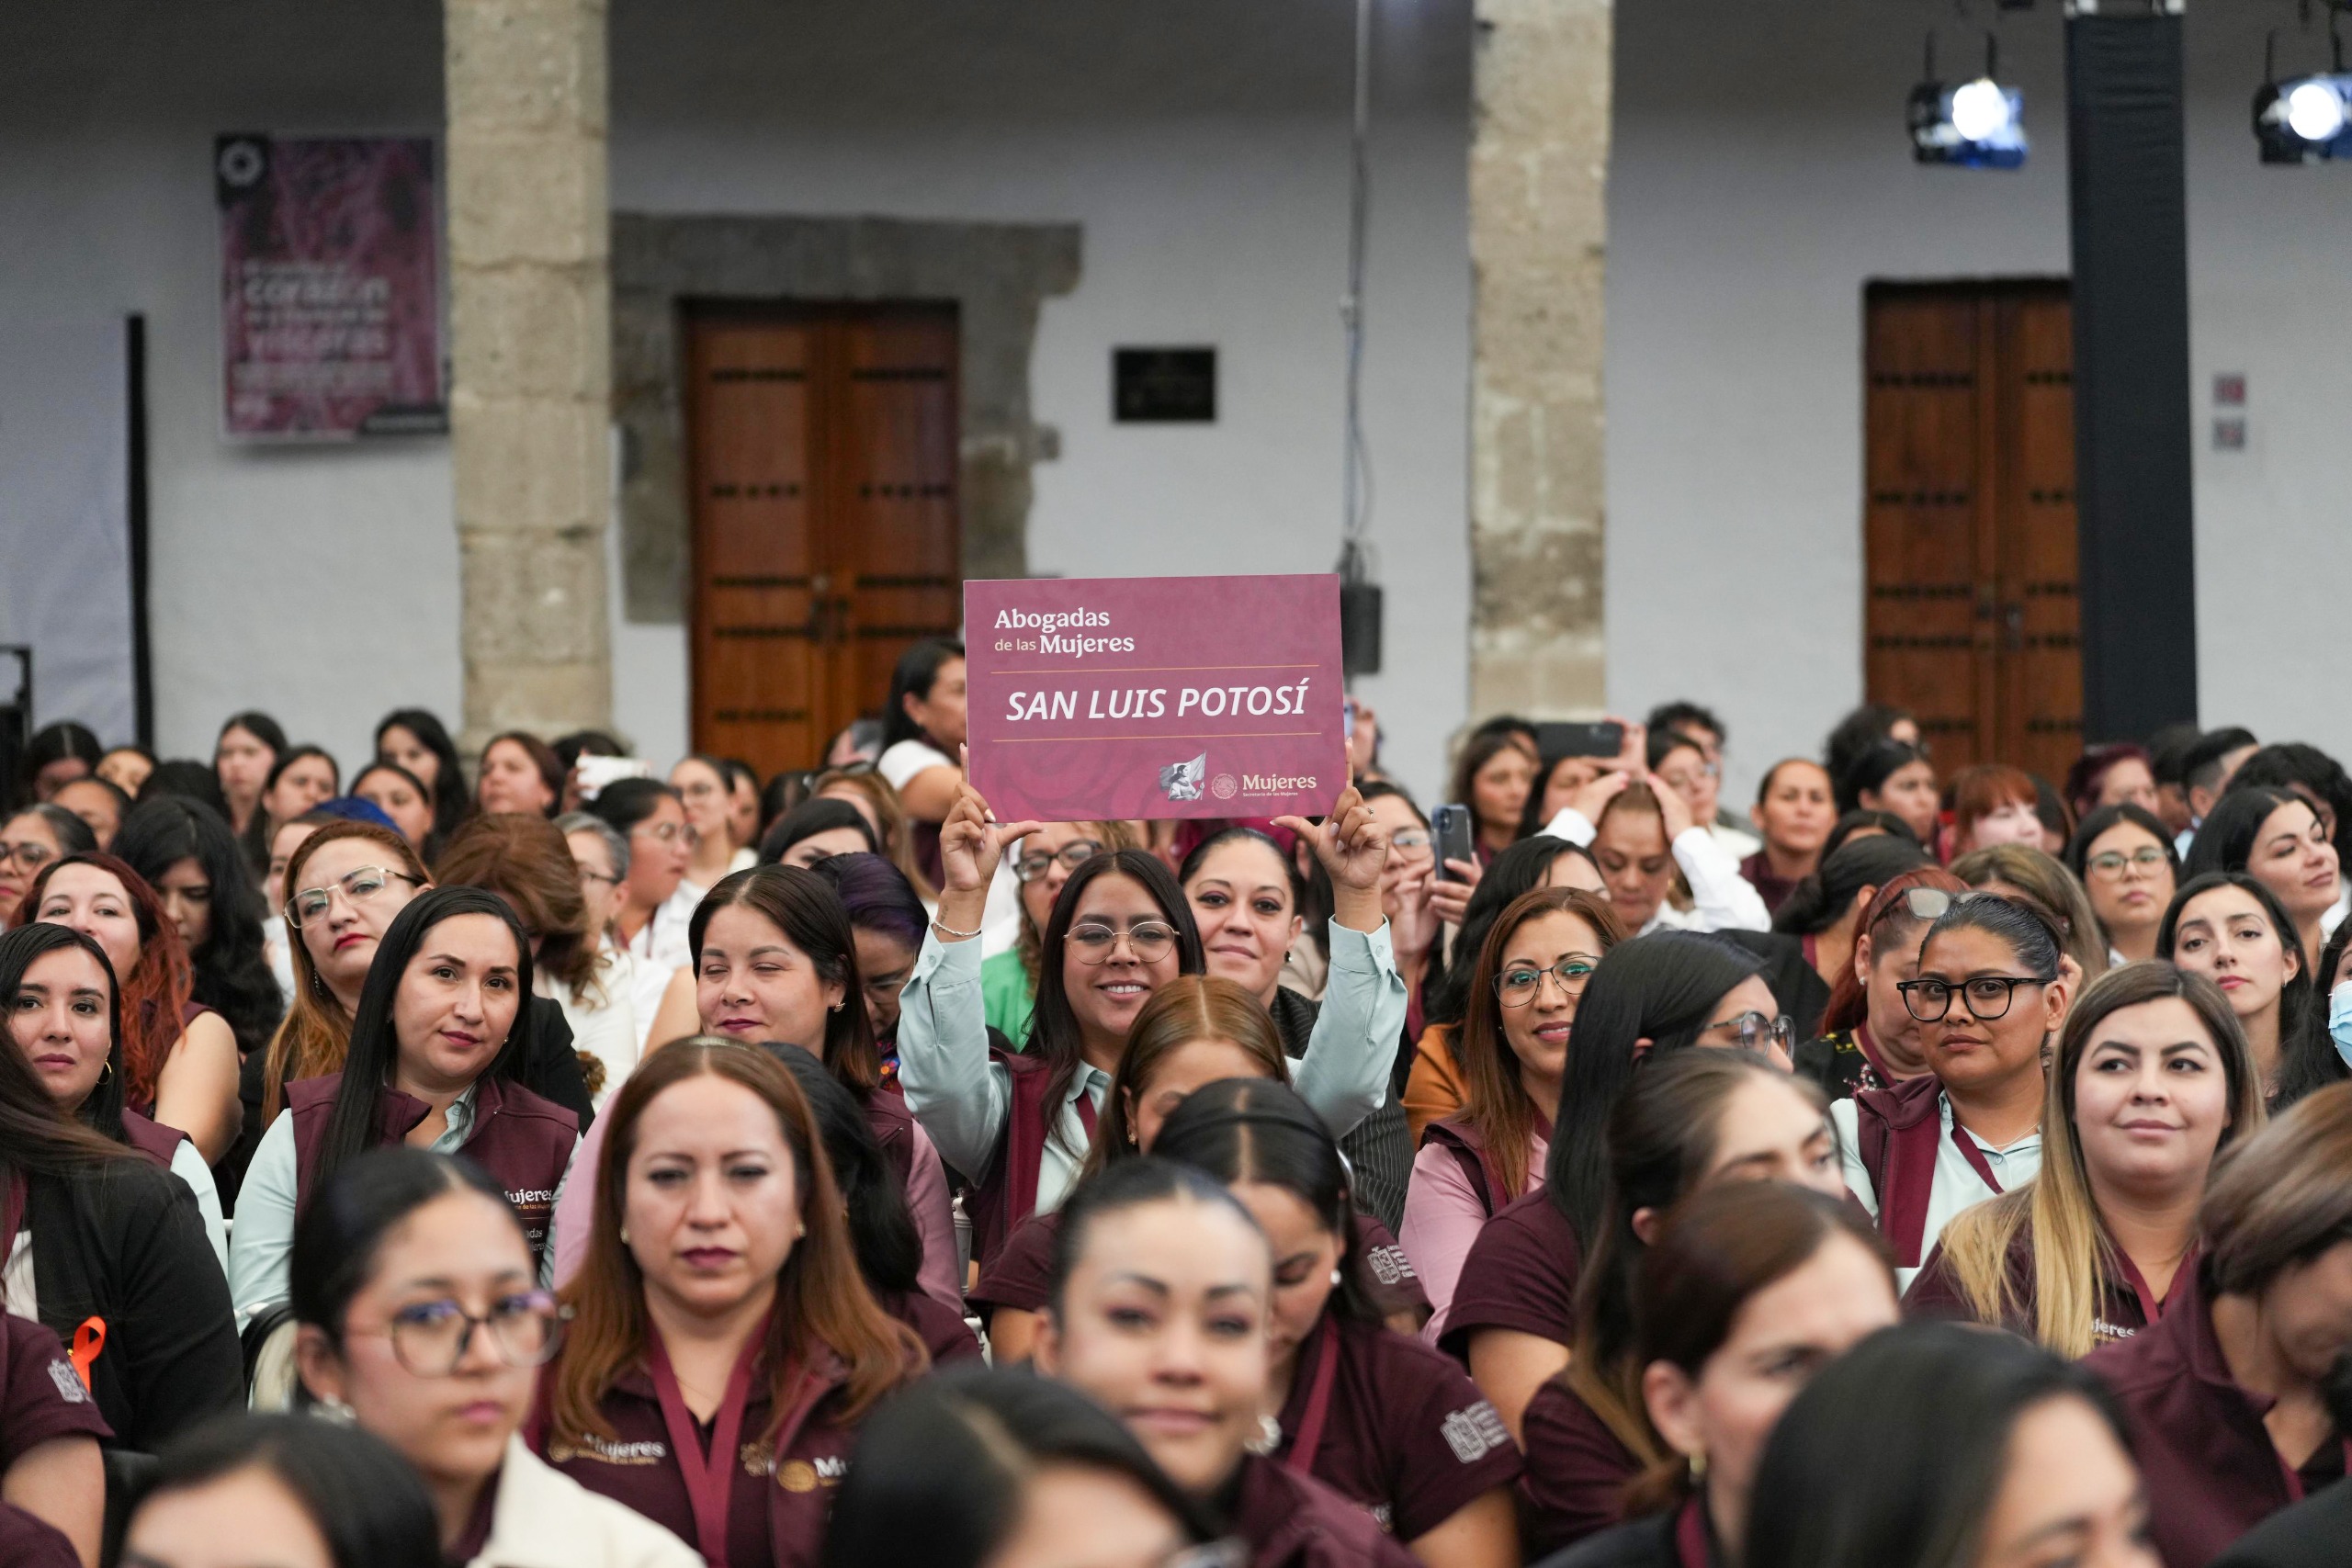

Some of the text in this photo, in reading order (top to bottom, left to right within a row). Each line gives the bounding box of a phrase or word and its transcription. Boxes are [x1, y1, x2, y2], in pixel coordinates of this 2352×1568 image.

[994, 607, 1110, 634] Abogadas
[994, 634, 1135, 659] de las Mujeres
[1006, 677, 1310, 721] SAN LUIS POTOSÍ
[1242, 773, 1317, 792] Mujeres
